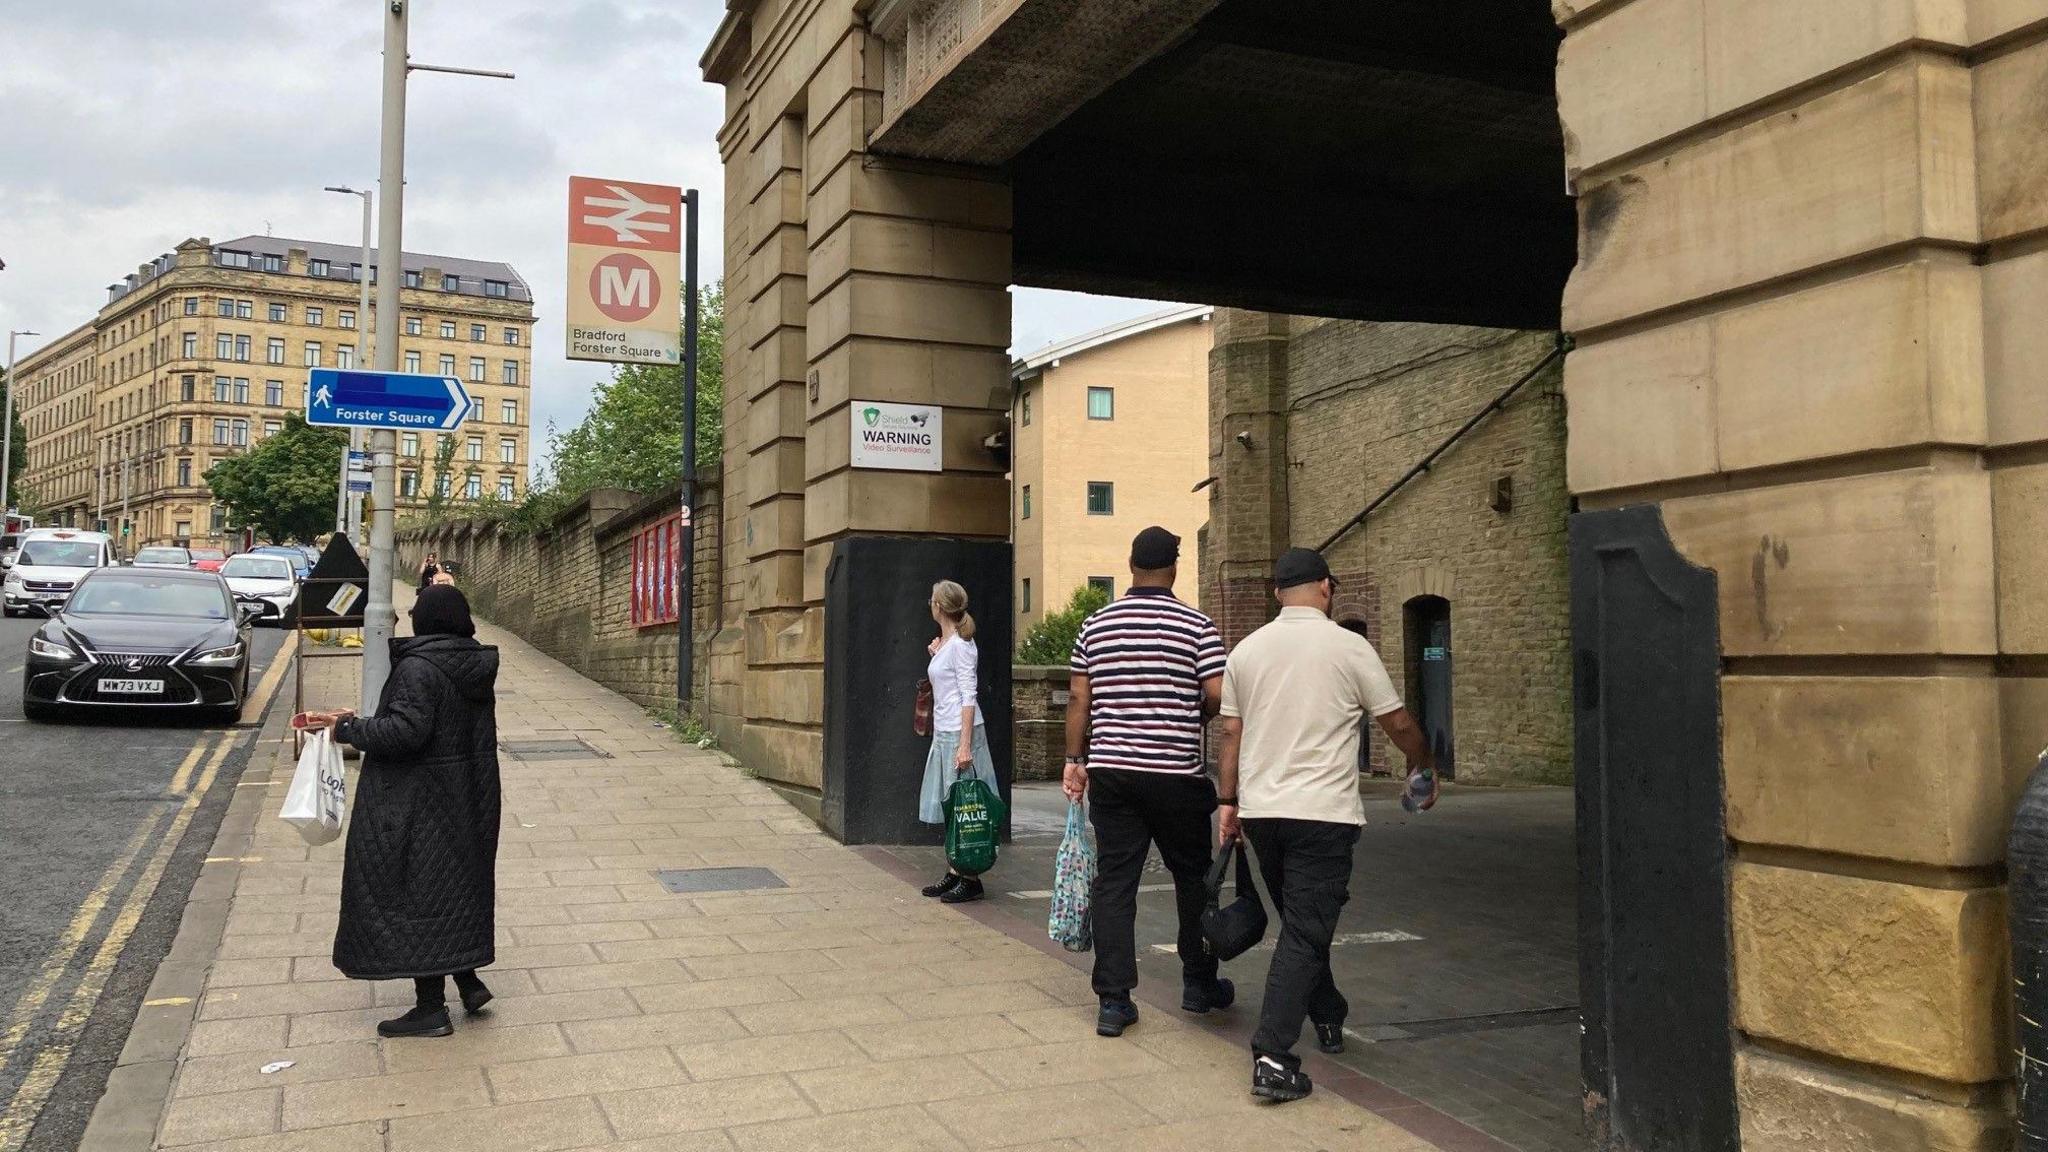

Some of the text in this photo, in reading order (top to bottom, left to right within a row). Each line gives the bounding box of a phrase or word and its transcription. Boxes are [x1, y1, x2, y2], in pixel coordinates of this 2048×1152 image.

[600, 265, 650, 308] M
[573, 328, 626, 342] Bradford
[573, 342, 661, 358] Forster Square
[336, 407, 436, 424] Forster Square
[882, 414, 908, 425] Shield
[863, 430, 931, 446] WARNING
[863, 443, 931, 455] Video Surveillance
[103, 680, 160, 691] MW73 VXJ
